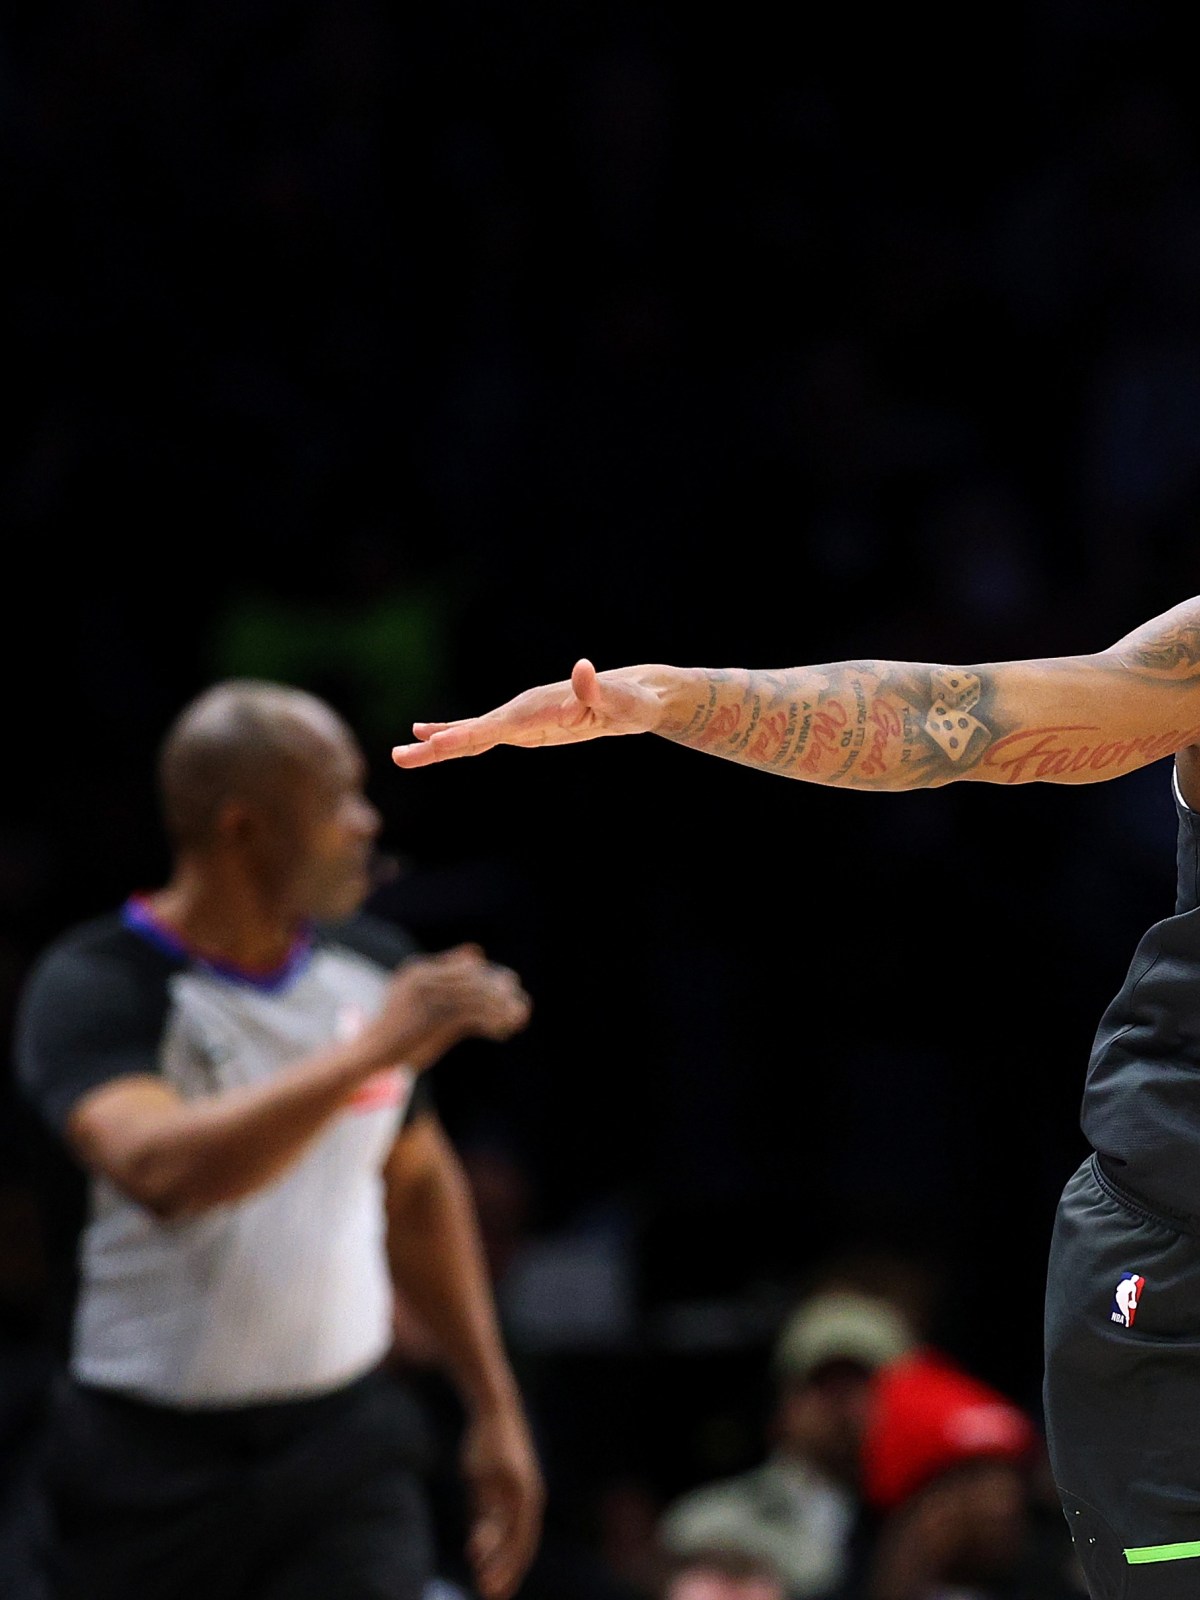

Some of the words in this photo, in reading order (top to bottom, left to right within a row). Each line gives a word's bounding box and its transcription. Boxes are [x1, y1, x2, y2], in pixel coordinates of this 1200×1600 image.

[802, 701, 812, 711] A
[840, 729, 853, 748] TO
[1111, 1311, 1125, 1324] NBA
